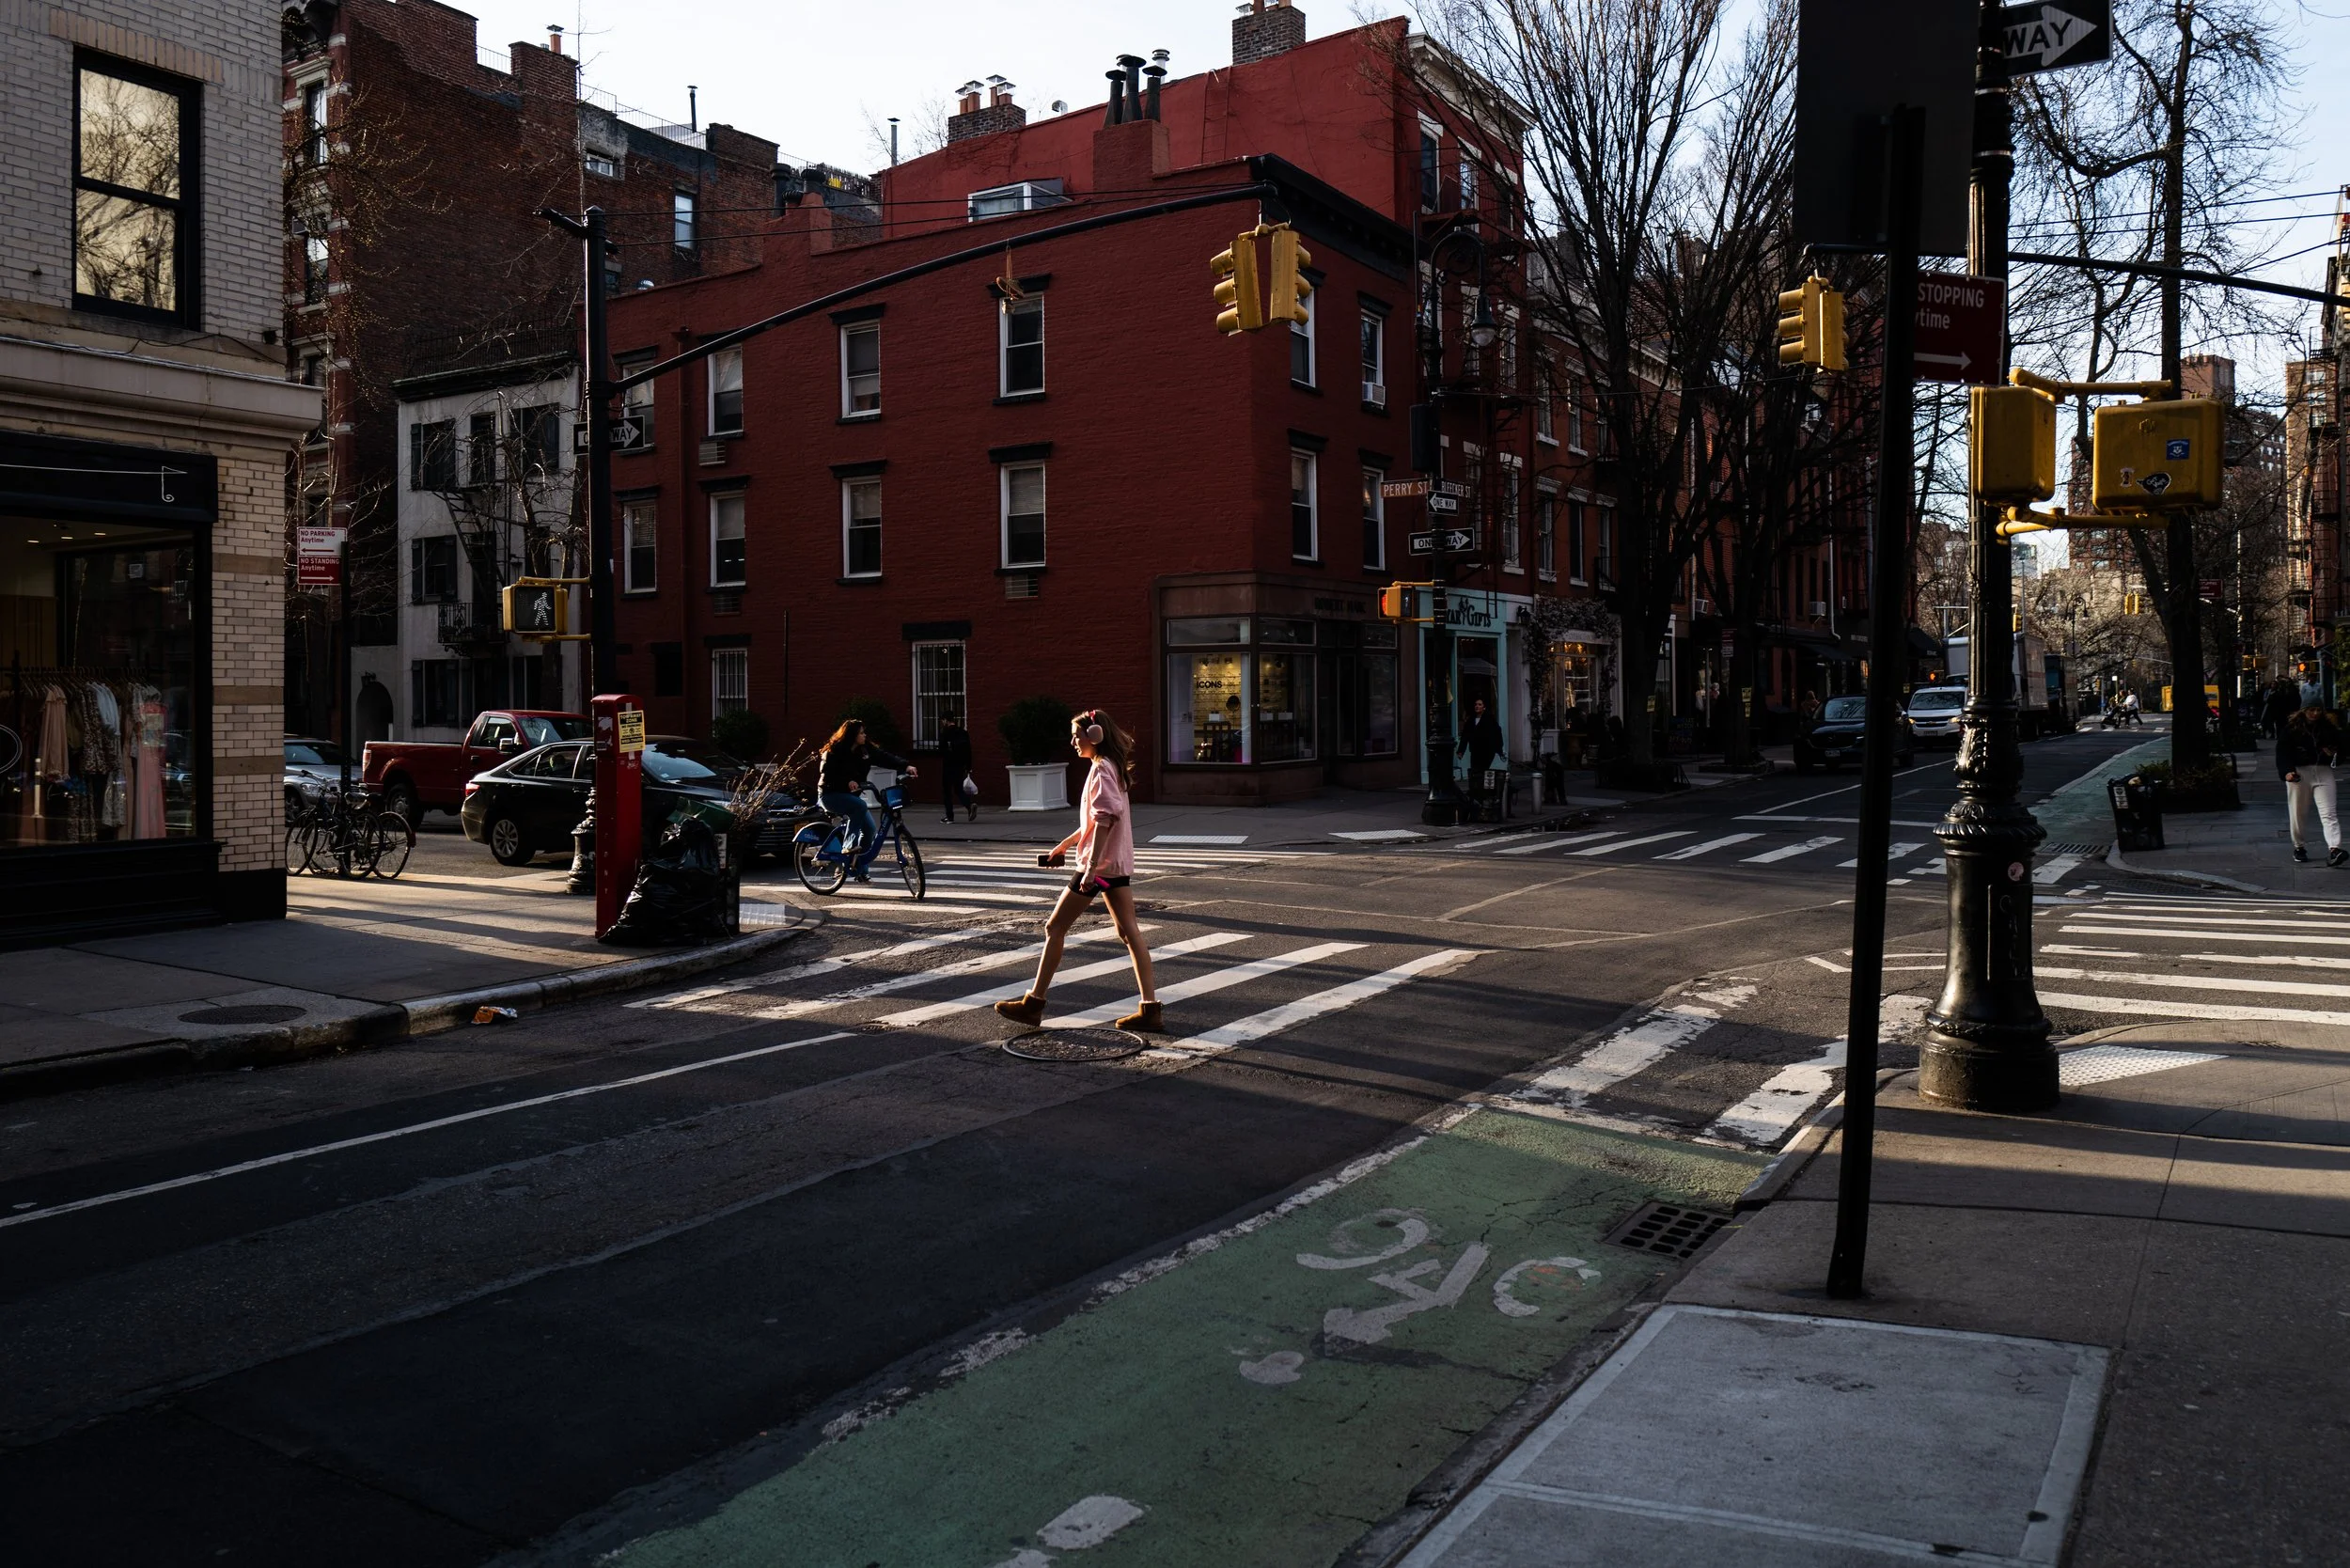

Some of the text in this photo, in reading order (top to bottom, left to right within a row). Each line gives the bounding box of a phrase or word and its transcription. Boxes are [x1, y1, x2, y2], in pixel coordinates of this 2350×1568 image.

[2004, 19, 2073, 55] WAY
[1918, 282, 1985, 308] STOPPING
[612, 427, 633, 441] WAY
[1384, 480, 1429, 497] PERRY ST
[1434, 497, 1454, 509] ONE WAY
[1418, 539, 1433, 548] ON
[1196, 680, 1223, 689] ICONS
